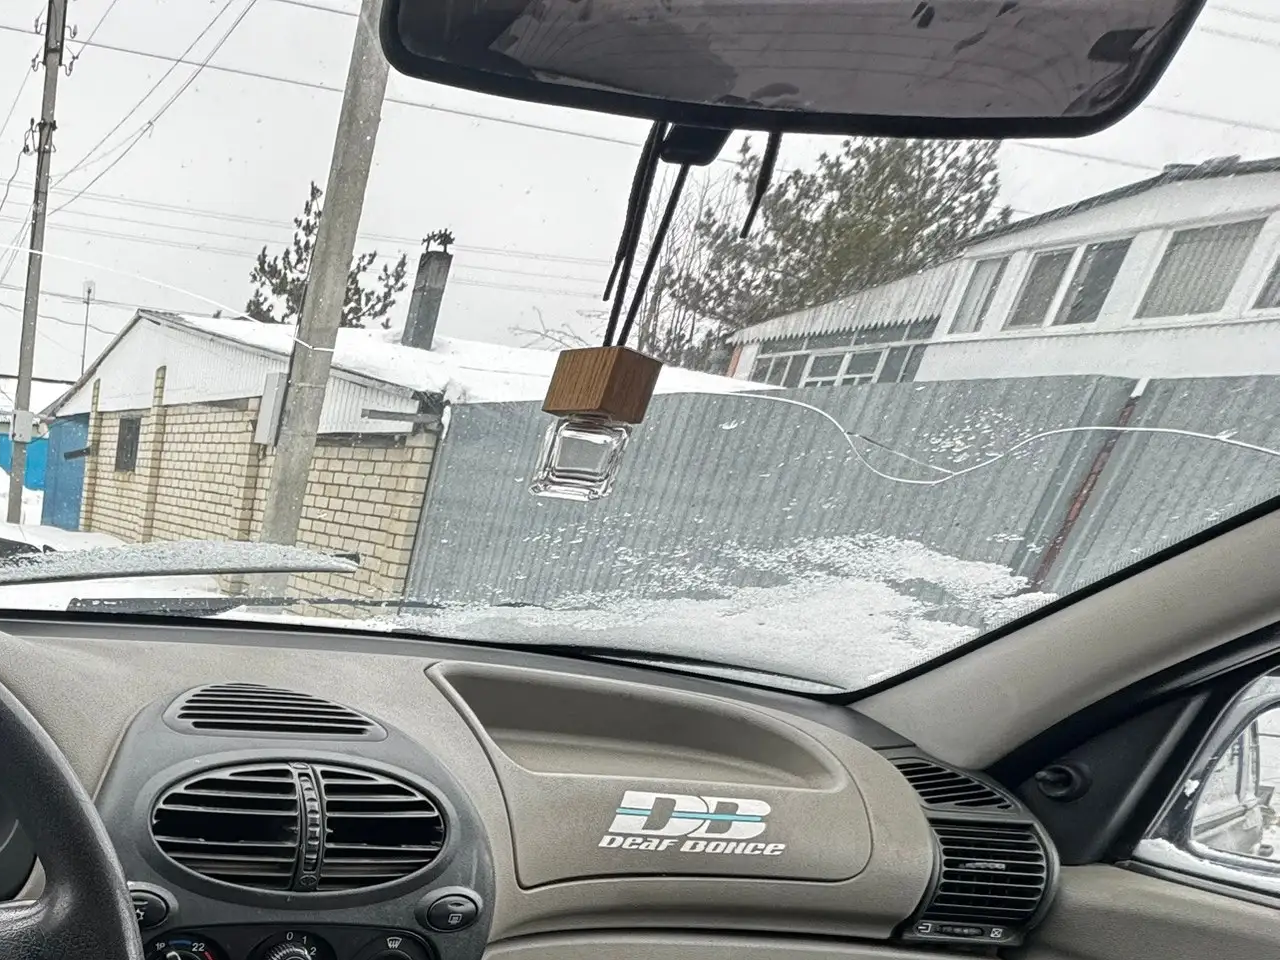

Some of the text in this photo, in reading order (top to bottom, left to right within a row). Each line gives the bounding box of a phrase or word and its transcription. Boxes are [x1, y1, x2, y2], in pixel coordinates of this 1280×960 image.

[608, 789, 772, 840] DB
[286, 931, 294, 941] 0
[302, 935, 308, 945] 1
[191, 943, 205, 952] 22
[310, 947, 317, 956] 2
